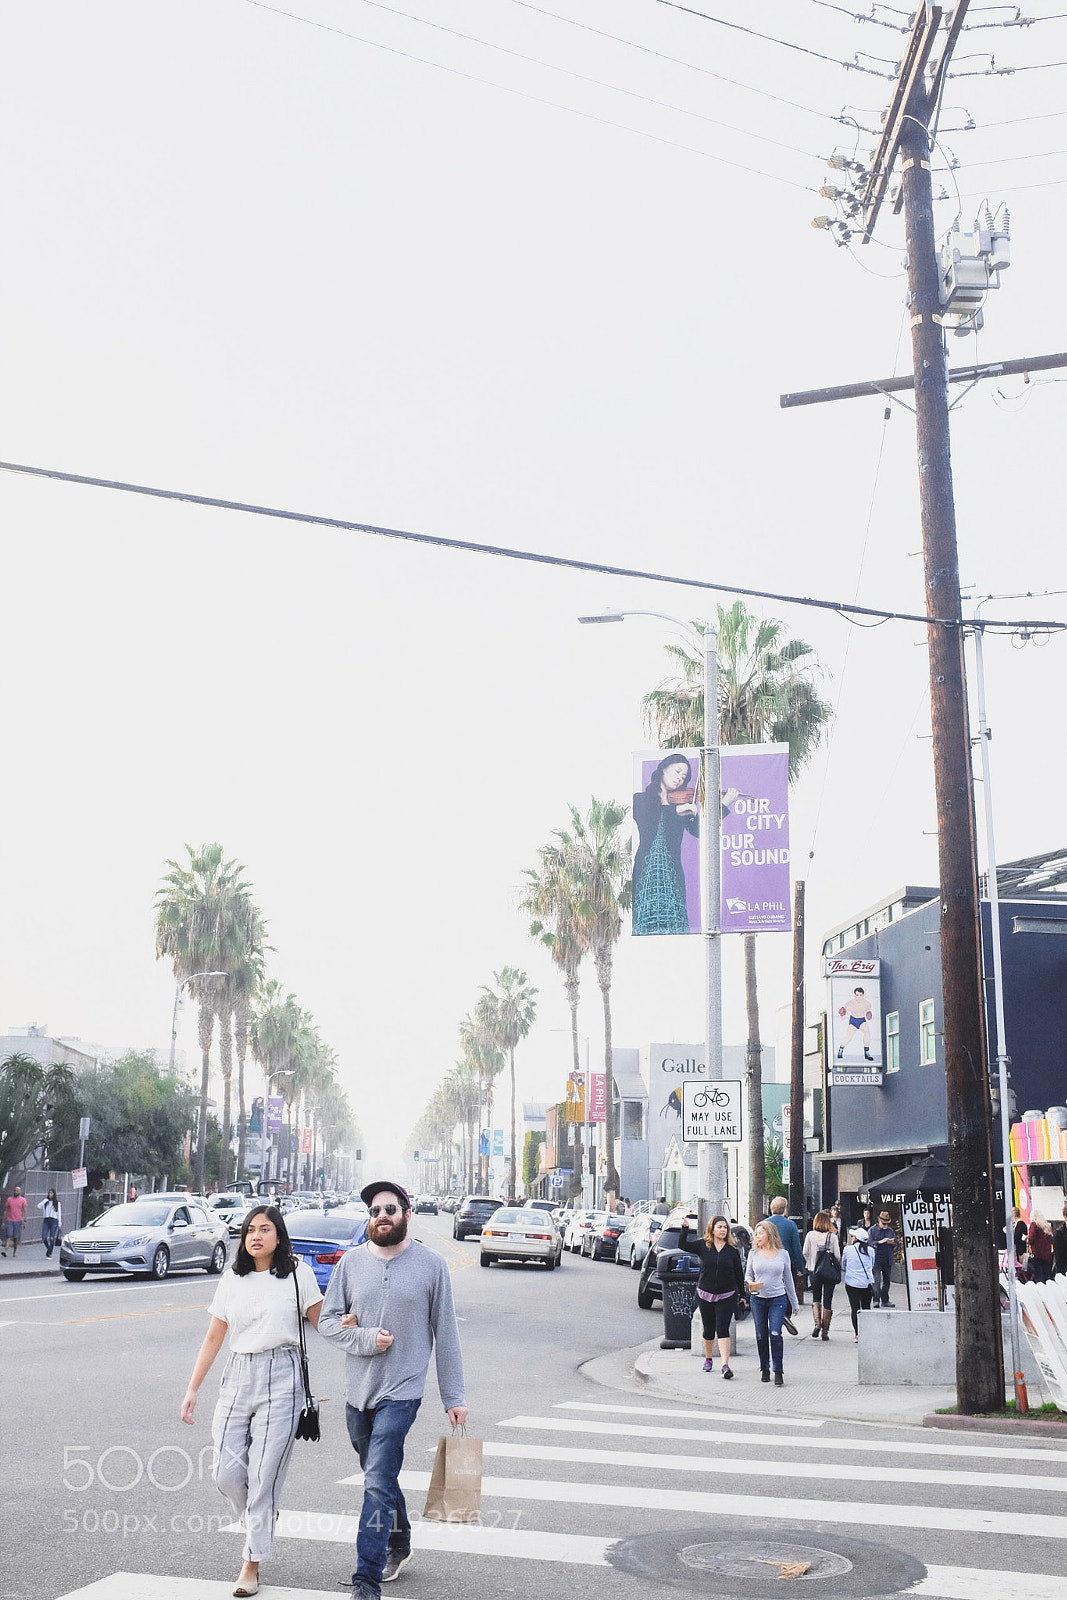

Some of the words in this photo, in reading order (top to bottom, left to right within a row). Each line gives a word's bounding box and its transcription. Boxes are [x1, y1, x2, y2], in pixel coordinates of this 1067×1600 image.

[734, 799, 771, 815] OUR
[746, 813, 787, 831] CITY
[721, 833, 755, 850] OUR
[730, 848, 790, 867] SOUND
[748, 902, 760, 911] LA
[762, 901, 786, 911] PHIL
[828, 960, 848, 970] The
[851, 960, 876, 971] Brig
[661, 1058, 706, 1074] Galle
[595, 1074, 605, 1087] LA
[835, 1075, 880, 1083] COCKTAILS
[595, 1088, 605, 1111] PHIL
[691, 1112, 709, 1122] MAY
[714, 1112, 733, 1121] USE
[687, 1126, 709, 1136] FULL
[714, 1125, 737, 1136] LANE
[881, 1193, 906, 1204] VALET
[905, 1234, 936, 1248] PARKI
